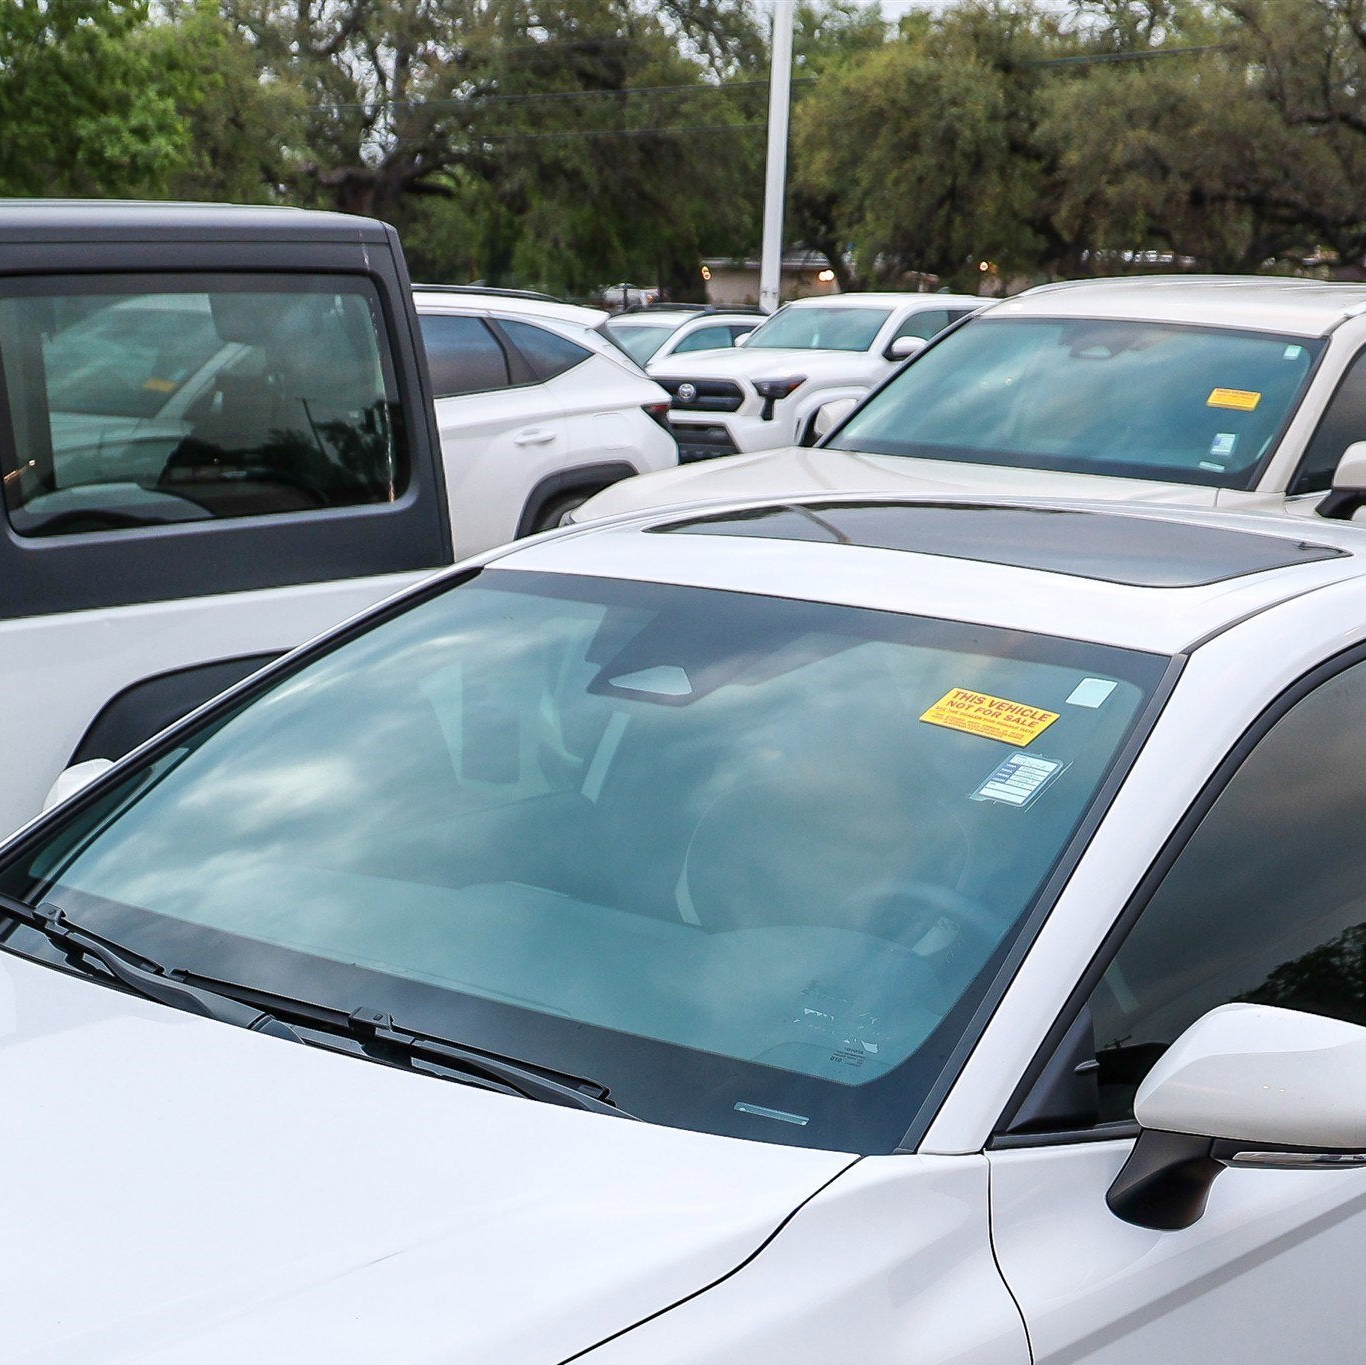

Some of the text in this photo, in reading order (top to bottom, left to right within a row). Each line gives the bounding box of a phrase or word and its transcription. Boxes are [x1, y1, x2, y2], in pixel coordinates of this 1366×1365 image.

[946, 700, 975, 712] NOT
[975, 706, 1002, 719] FOR
[1004, 714, 1039, 728] SALE
[952, 691, 1051, 722] THIS VEHICLE
